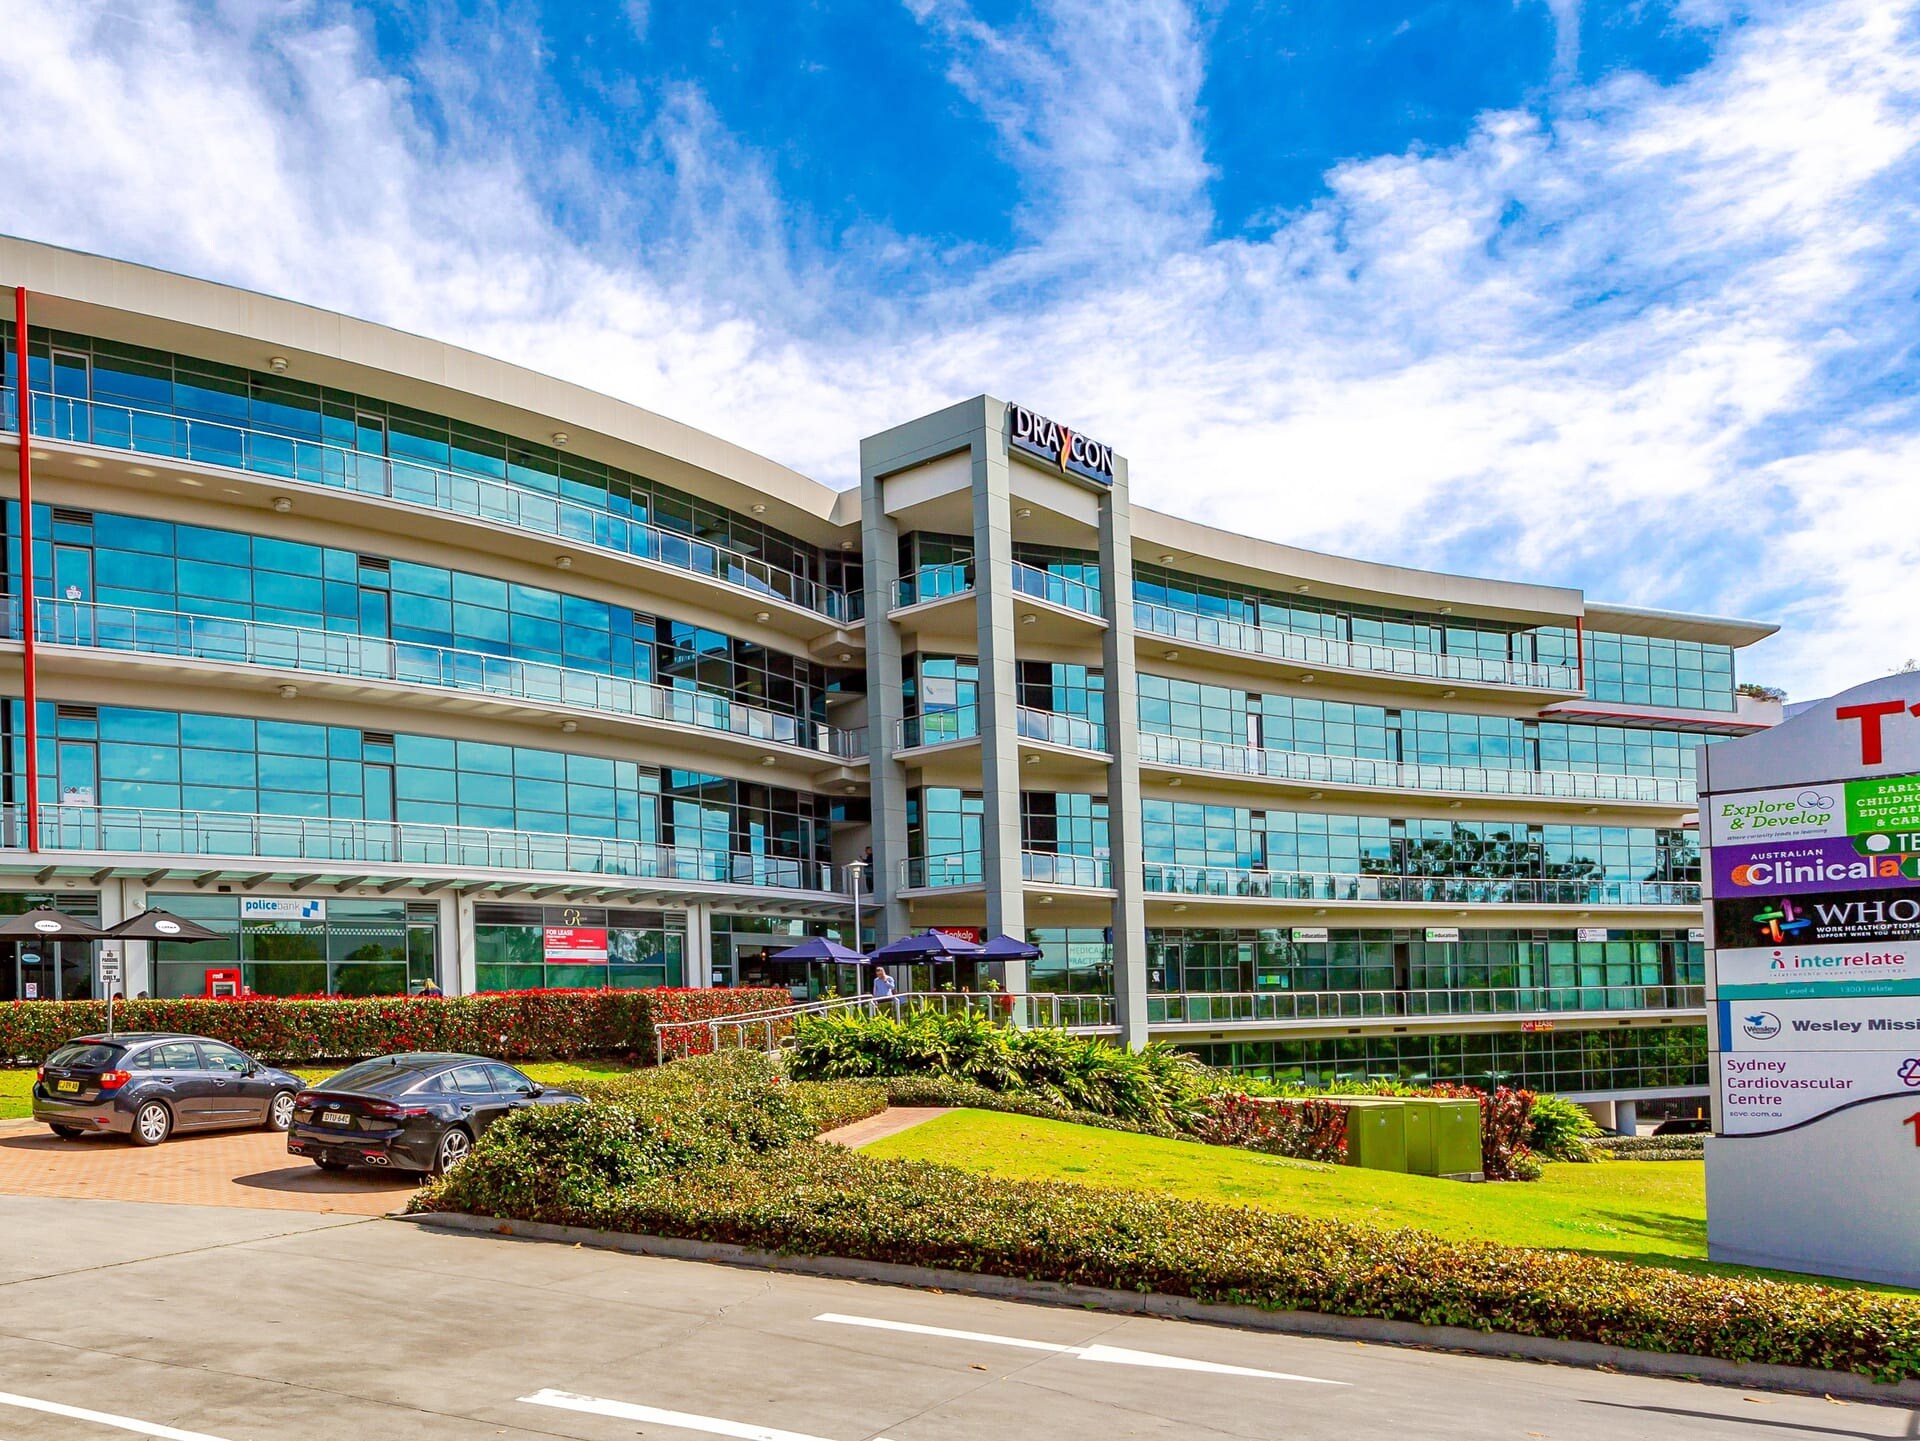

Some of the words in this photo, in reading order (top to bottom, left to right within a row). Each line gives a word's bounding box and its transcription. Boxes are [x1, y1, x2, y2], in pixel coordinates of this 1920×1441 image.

[1016, 405, 1114, 476] DRAYCON
[1720, 799, 1796, 818] Explore
[1859, 804, 1920, 818] EDUCAT
[1730, 817, 1745, 830] &
[1751, 810, 1831, 829] Develop
[1876, 819, 1886, 827] &
[1750, 848, 1823, 861] AUSTRALIAN
[245, 900, 300, 912] policebank
[1845, 924, 1879, 932] HEALTH
[1794, 952, 1905, 969] interrelate
[1785, 987, 1808, 995] Level
[1747, 1025, 1777, 1034] Wesley
[1792, 1019, 1863, 1034] Wesley
[1727, 1059, 1787, 1074] Sydney
[1727, 1077, 1854, 1089] Cardiovascular
[1728, 1093, 1783, 1105] Centre
